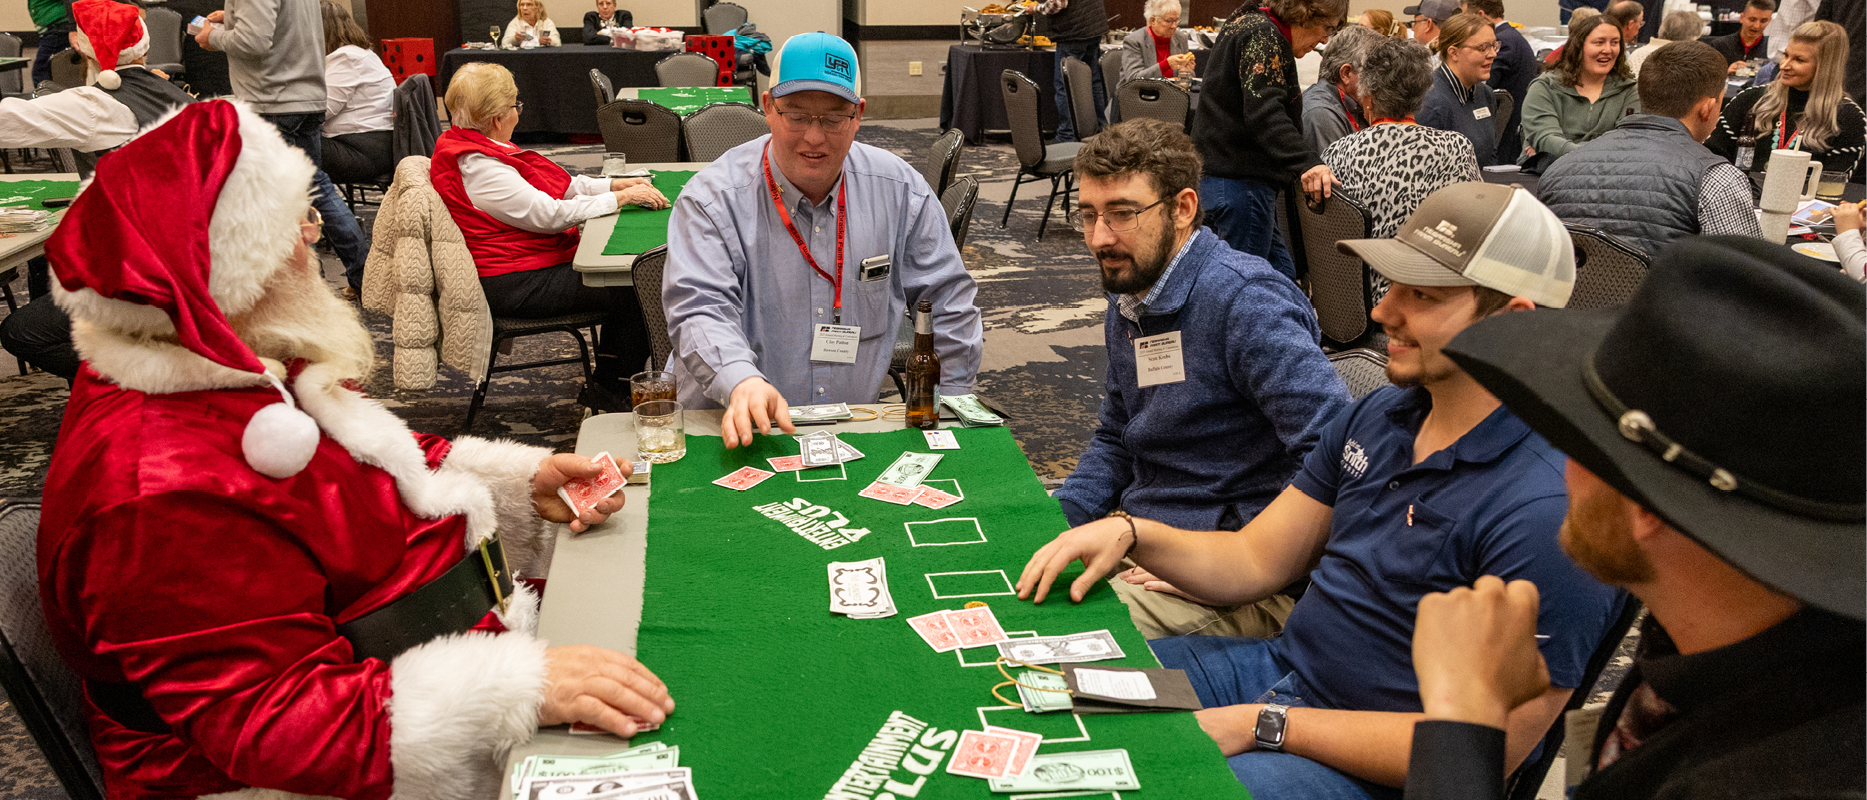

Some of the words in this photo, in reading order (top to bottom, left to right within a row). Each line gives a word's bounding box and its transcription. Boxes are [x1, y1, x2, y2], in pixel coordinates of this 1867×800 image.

[787, 223, 804, 246] Bureau
[1342, 444, 1369, 474] Smith
[752, 501, 851, 550] ENTERTAINMENT
[782, 497, 871, 542] PLUS
[821, 710, 929, 800] NTERTAINMENT
[1086, 767, 1124, 776] $100
